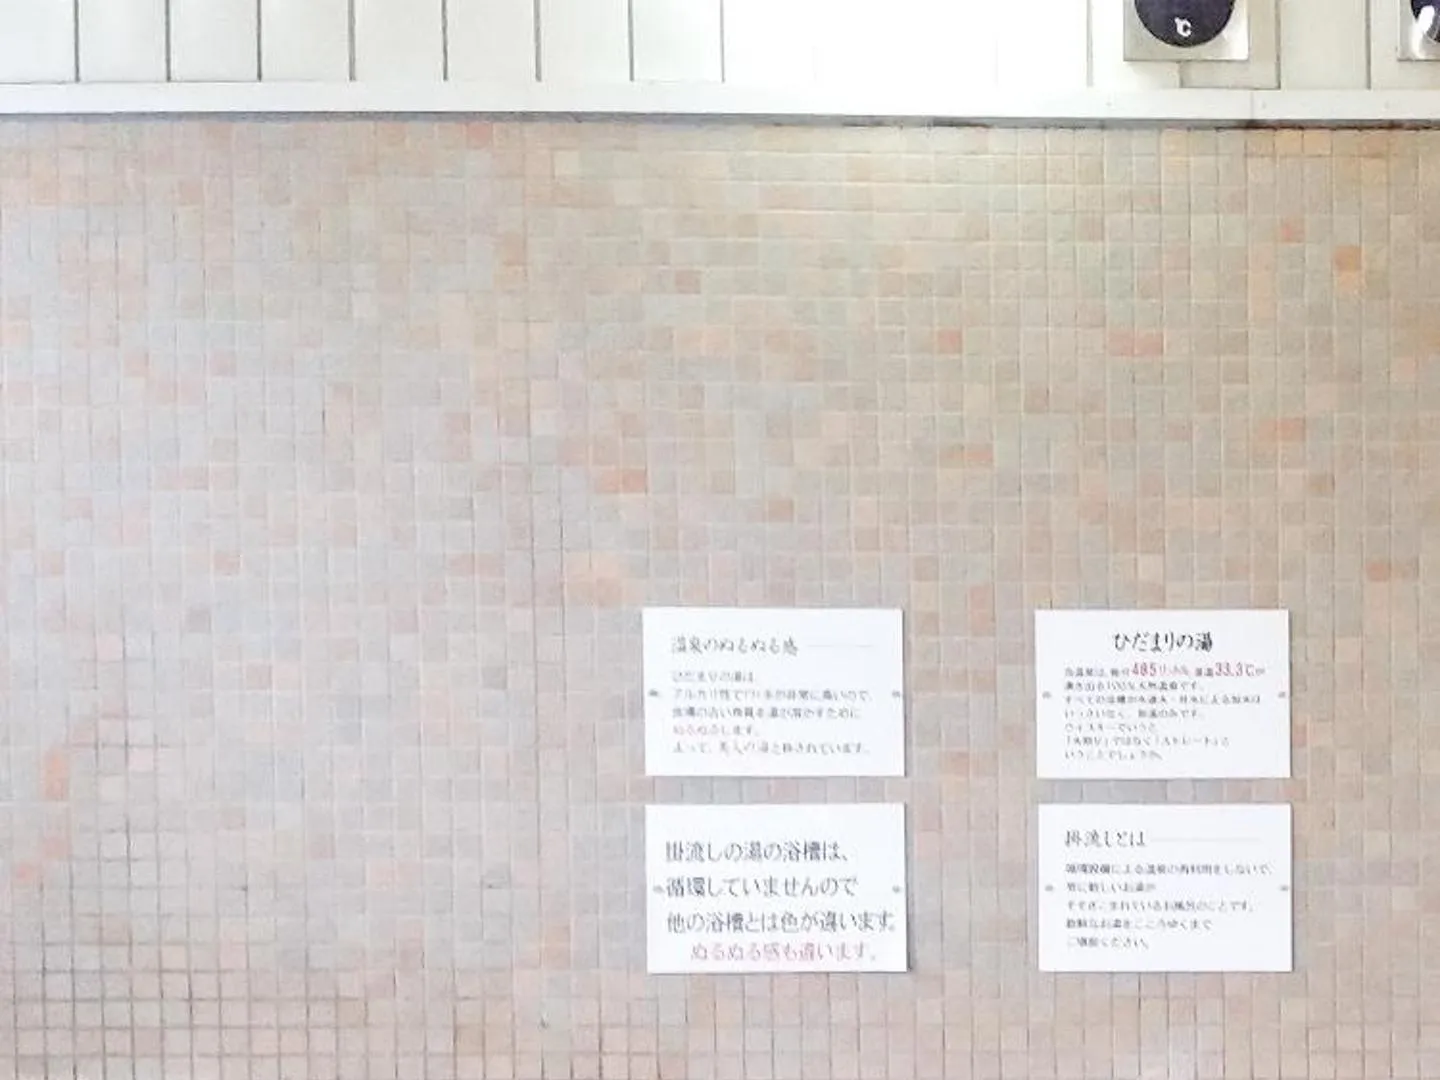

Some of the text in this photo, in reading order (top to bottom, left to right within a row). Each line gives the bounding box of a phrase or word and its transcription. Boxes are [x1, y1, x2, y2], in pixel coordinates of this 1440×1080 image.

[672, 635, 799, 656] 温泉のぬるぬる感
[1113, 631, 1214, 652] ひだまりの湯
[1065, 829, 1146, 848] 掛流しとは
[665, 840, 849, 863] 掛流しの湯の浴槽は、
[666, 875, 859, 898] 循環していませんので
[667, 911, 896, 934] 他の浴槽とは色が違います。
[690, 942, 877, 961] ぬるぬる感も違います。
